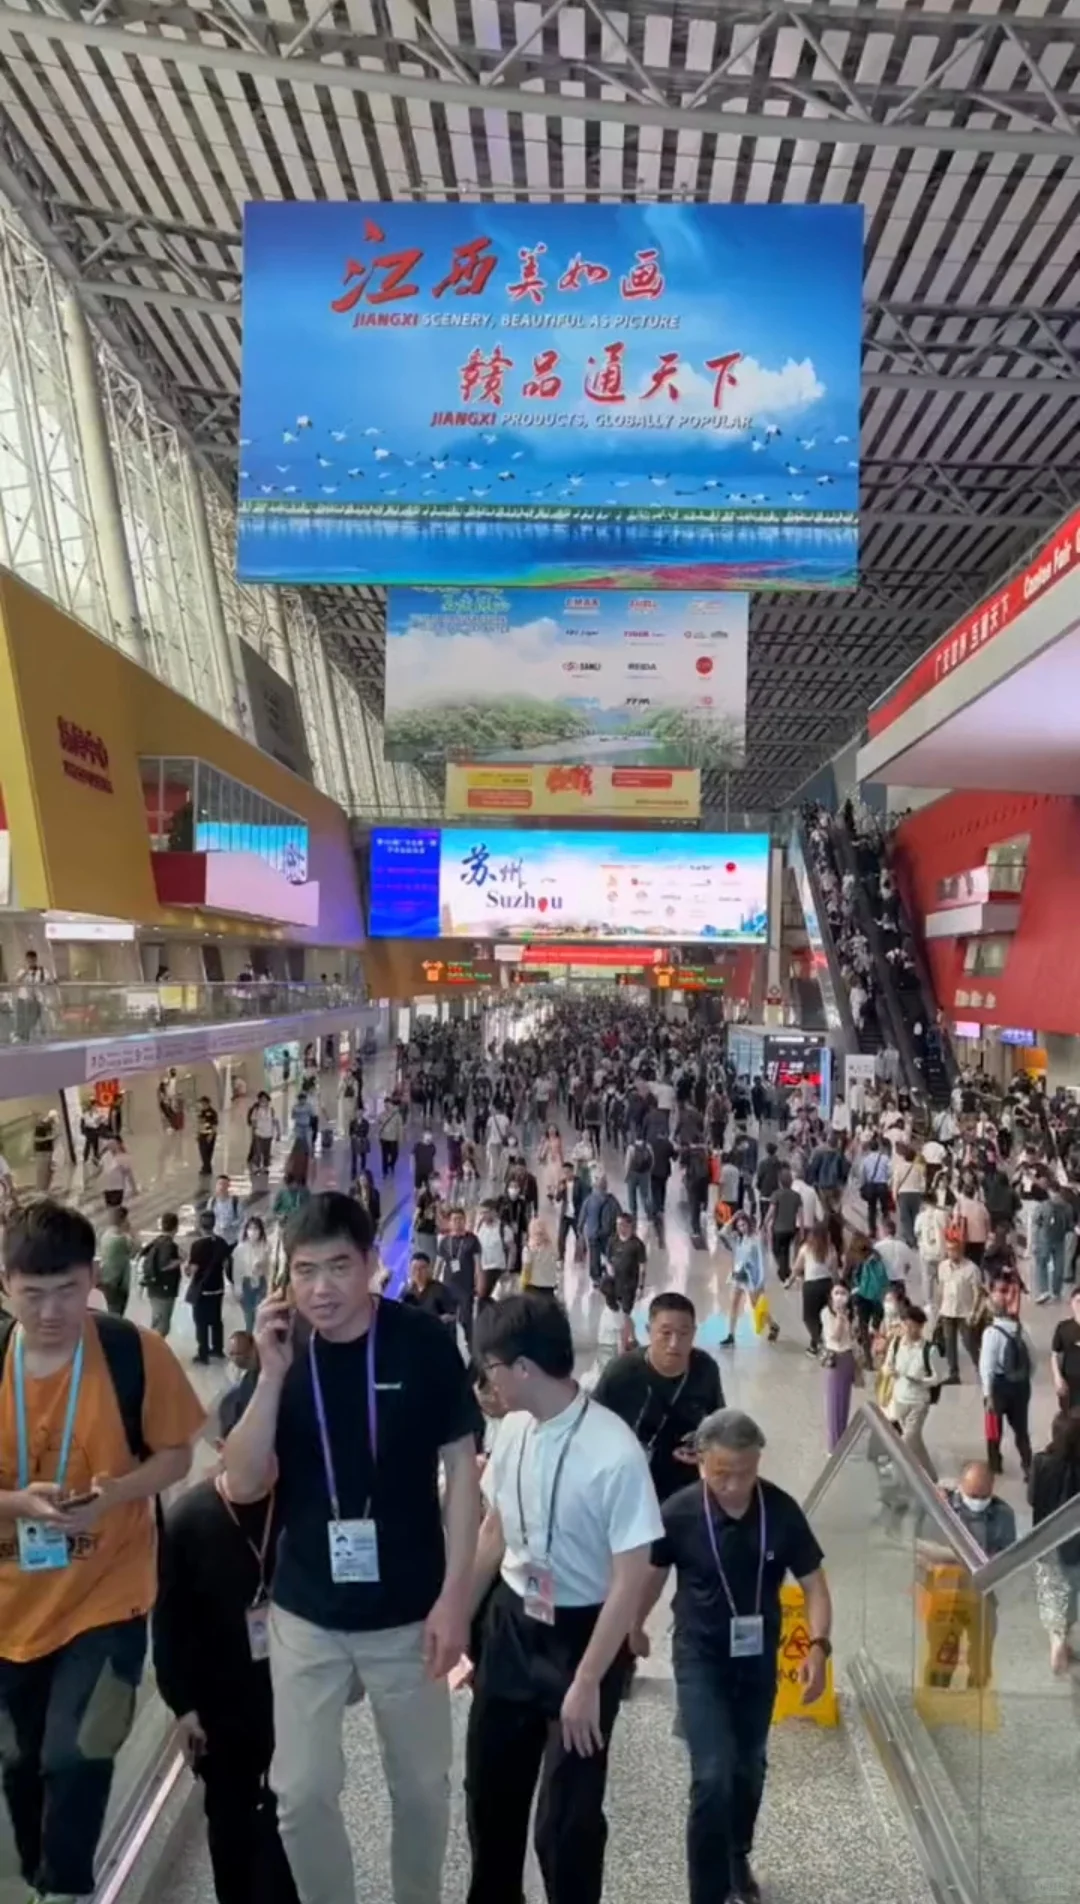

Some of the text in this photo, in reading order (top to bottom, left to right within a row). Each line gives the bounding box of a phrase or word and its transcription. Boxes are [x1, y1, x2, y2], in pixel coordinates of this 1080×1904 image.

[331, 218, 666, 313] 江西美如画
[353, 312, 681, 330] JIANGXI SCENERY, BEAUTIFUL AS PICTURE
[458, 341, 746, 407] 赣品通天下
[430, 411, 755, 430] JIANGXI PRODUCTS, GLOBALLY POPULAR
[459, 842, 526, 890] 苏州
[486, 889, 564, 914] Suzhou
